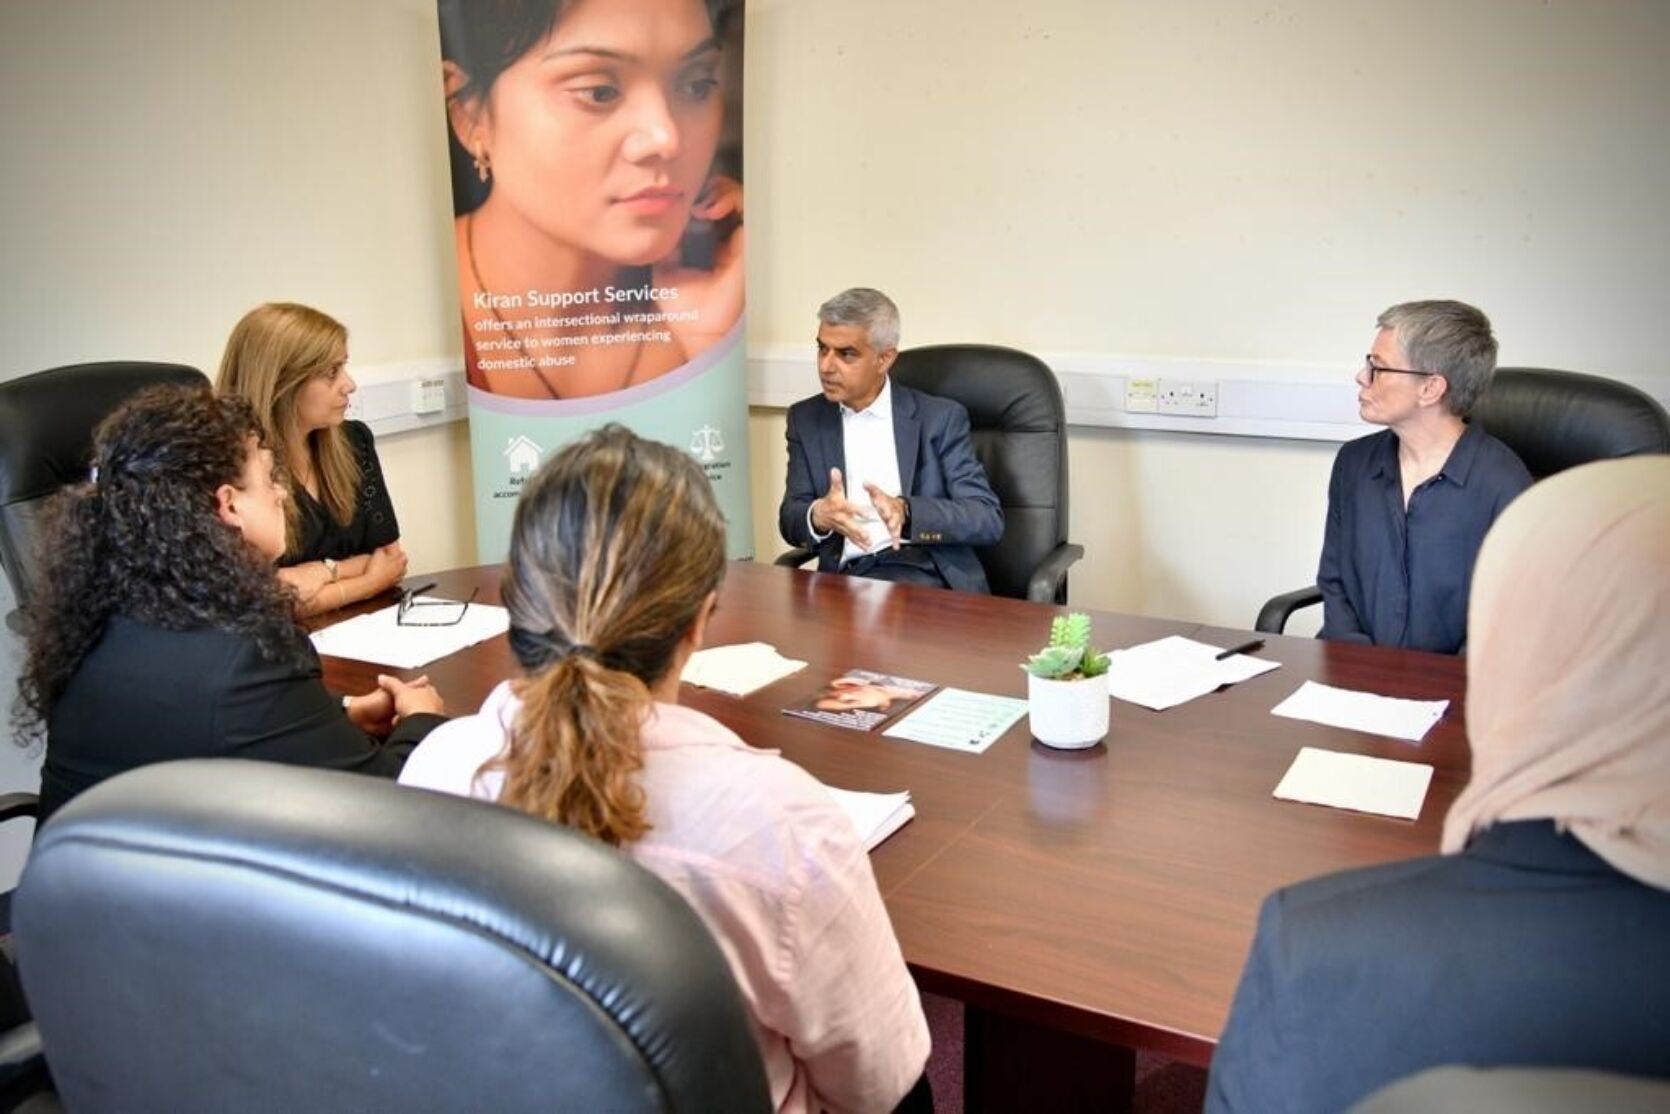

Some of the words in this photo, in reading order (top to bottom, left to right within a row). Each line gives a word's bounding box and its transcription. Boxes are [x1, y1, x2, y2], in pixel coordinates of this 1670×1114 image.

[473, 291, 522, 310] Kiran
[526, 288, 599, 308] Support
[604, 284, 680, 302] Services
[474, 318, 513, 331] offers
[514, 318, 532, 329] an
[534, 312, 621, 328] intersectional
[623, 309, 699, 323] wraparound
[475, 338, 522, 351] service
[524, 337, 540, 348] to
[542, 334, 589, 347] women
[591, 329, 672, 345] experiencing
[477, 356, 536, 370] domestic
[538, 354, 575, 367] abuse
